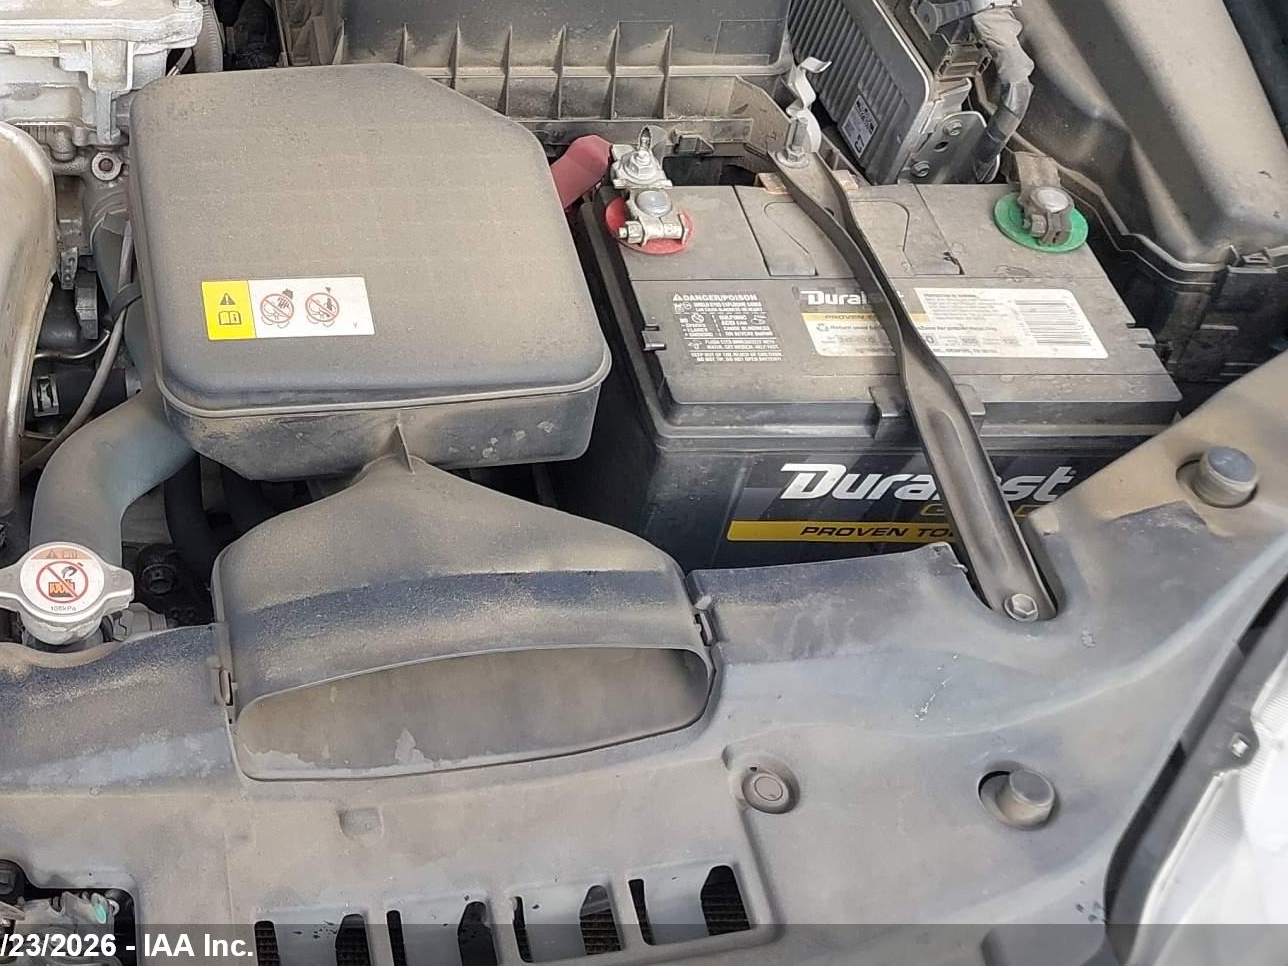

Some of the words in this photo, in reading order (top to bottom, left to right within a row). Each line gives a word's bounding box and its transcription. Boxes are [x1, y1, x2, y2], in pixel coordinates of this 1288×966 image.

[800, 290, 906, 305] Duralt
[779, 463, 1074, 502] Durast
[800, 526, 905, 537] PROVEN
